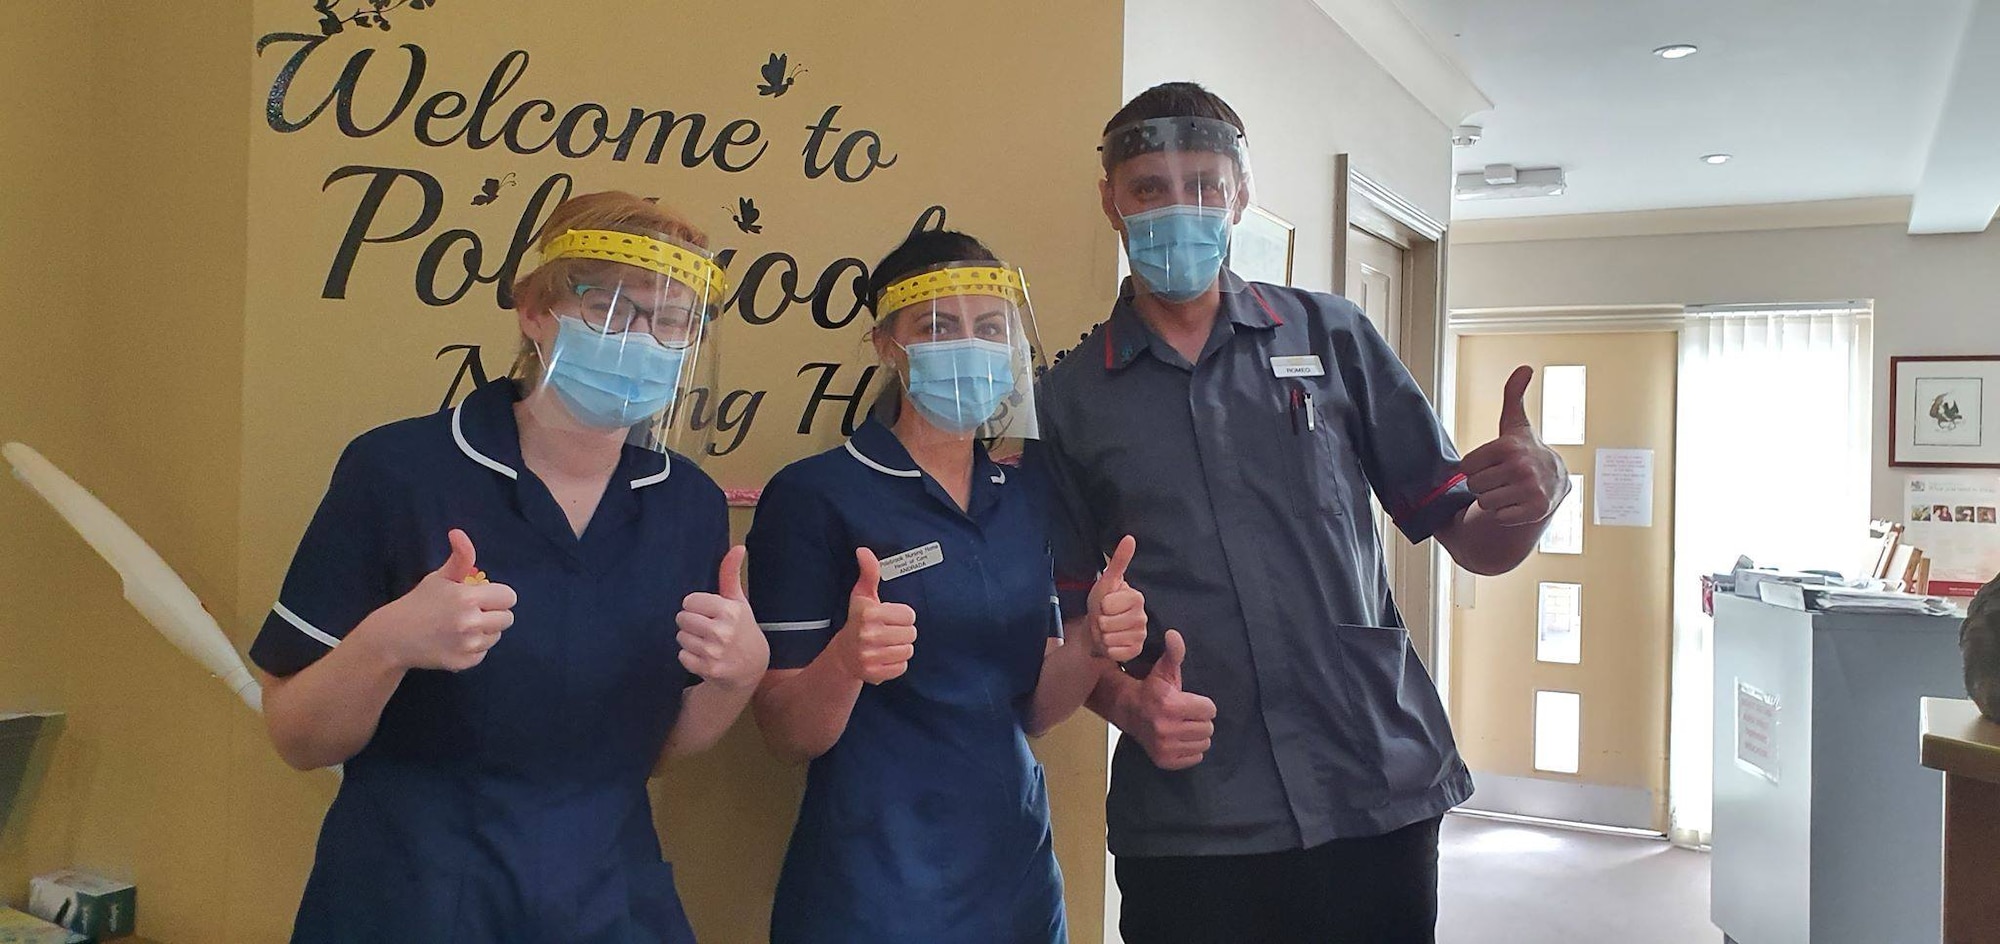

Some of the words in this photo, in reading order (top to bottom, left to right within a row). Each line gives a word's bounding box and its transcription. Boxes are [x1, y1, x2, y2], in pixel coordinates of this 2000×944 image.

[256, 32, 769, 173] Welcome
[800, 105, 898, 184] to
[320, 164, 947, 331] Poloo
